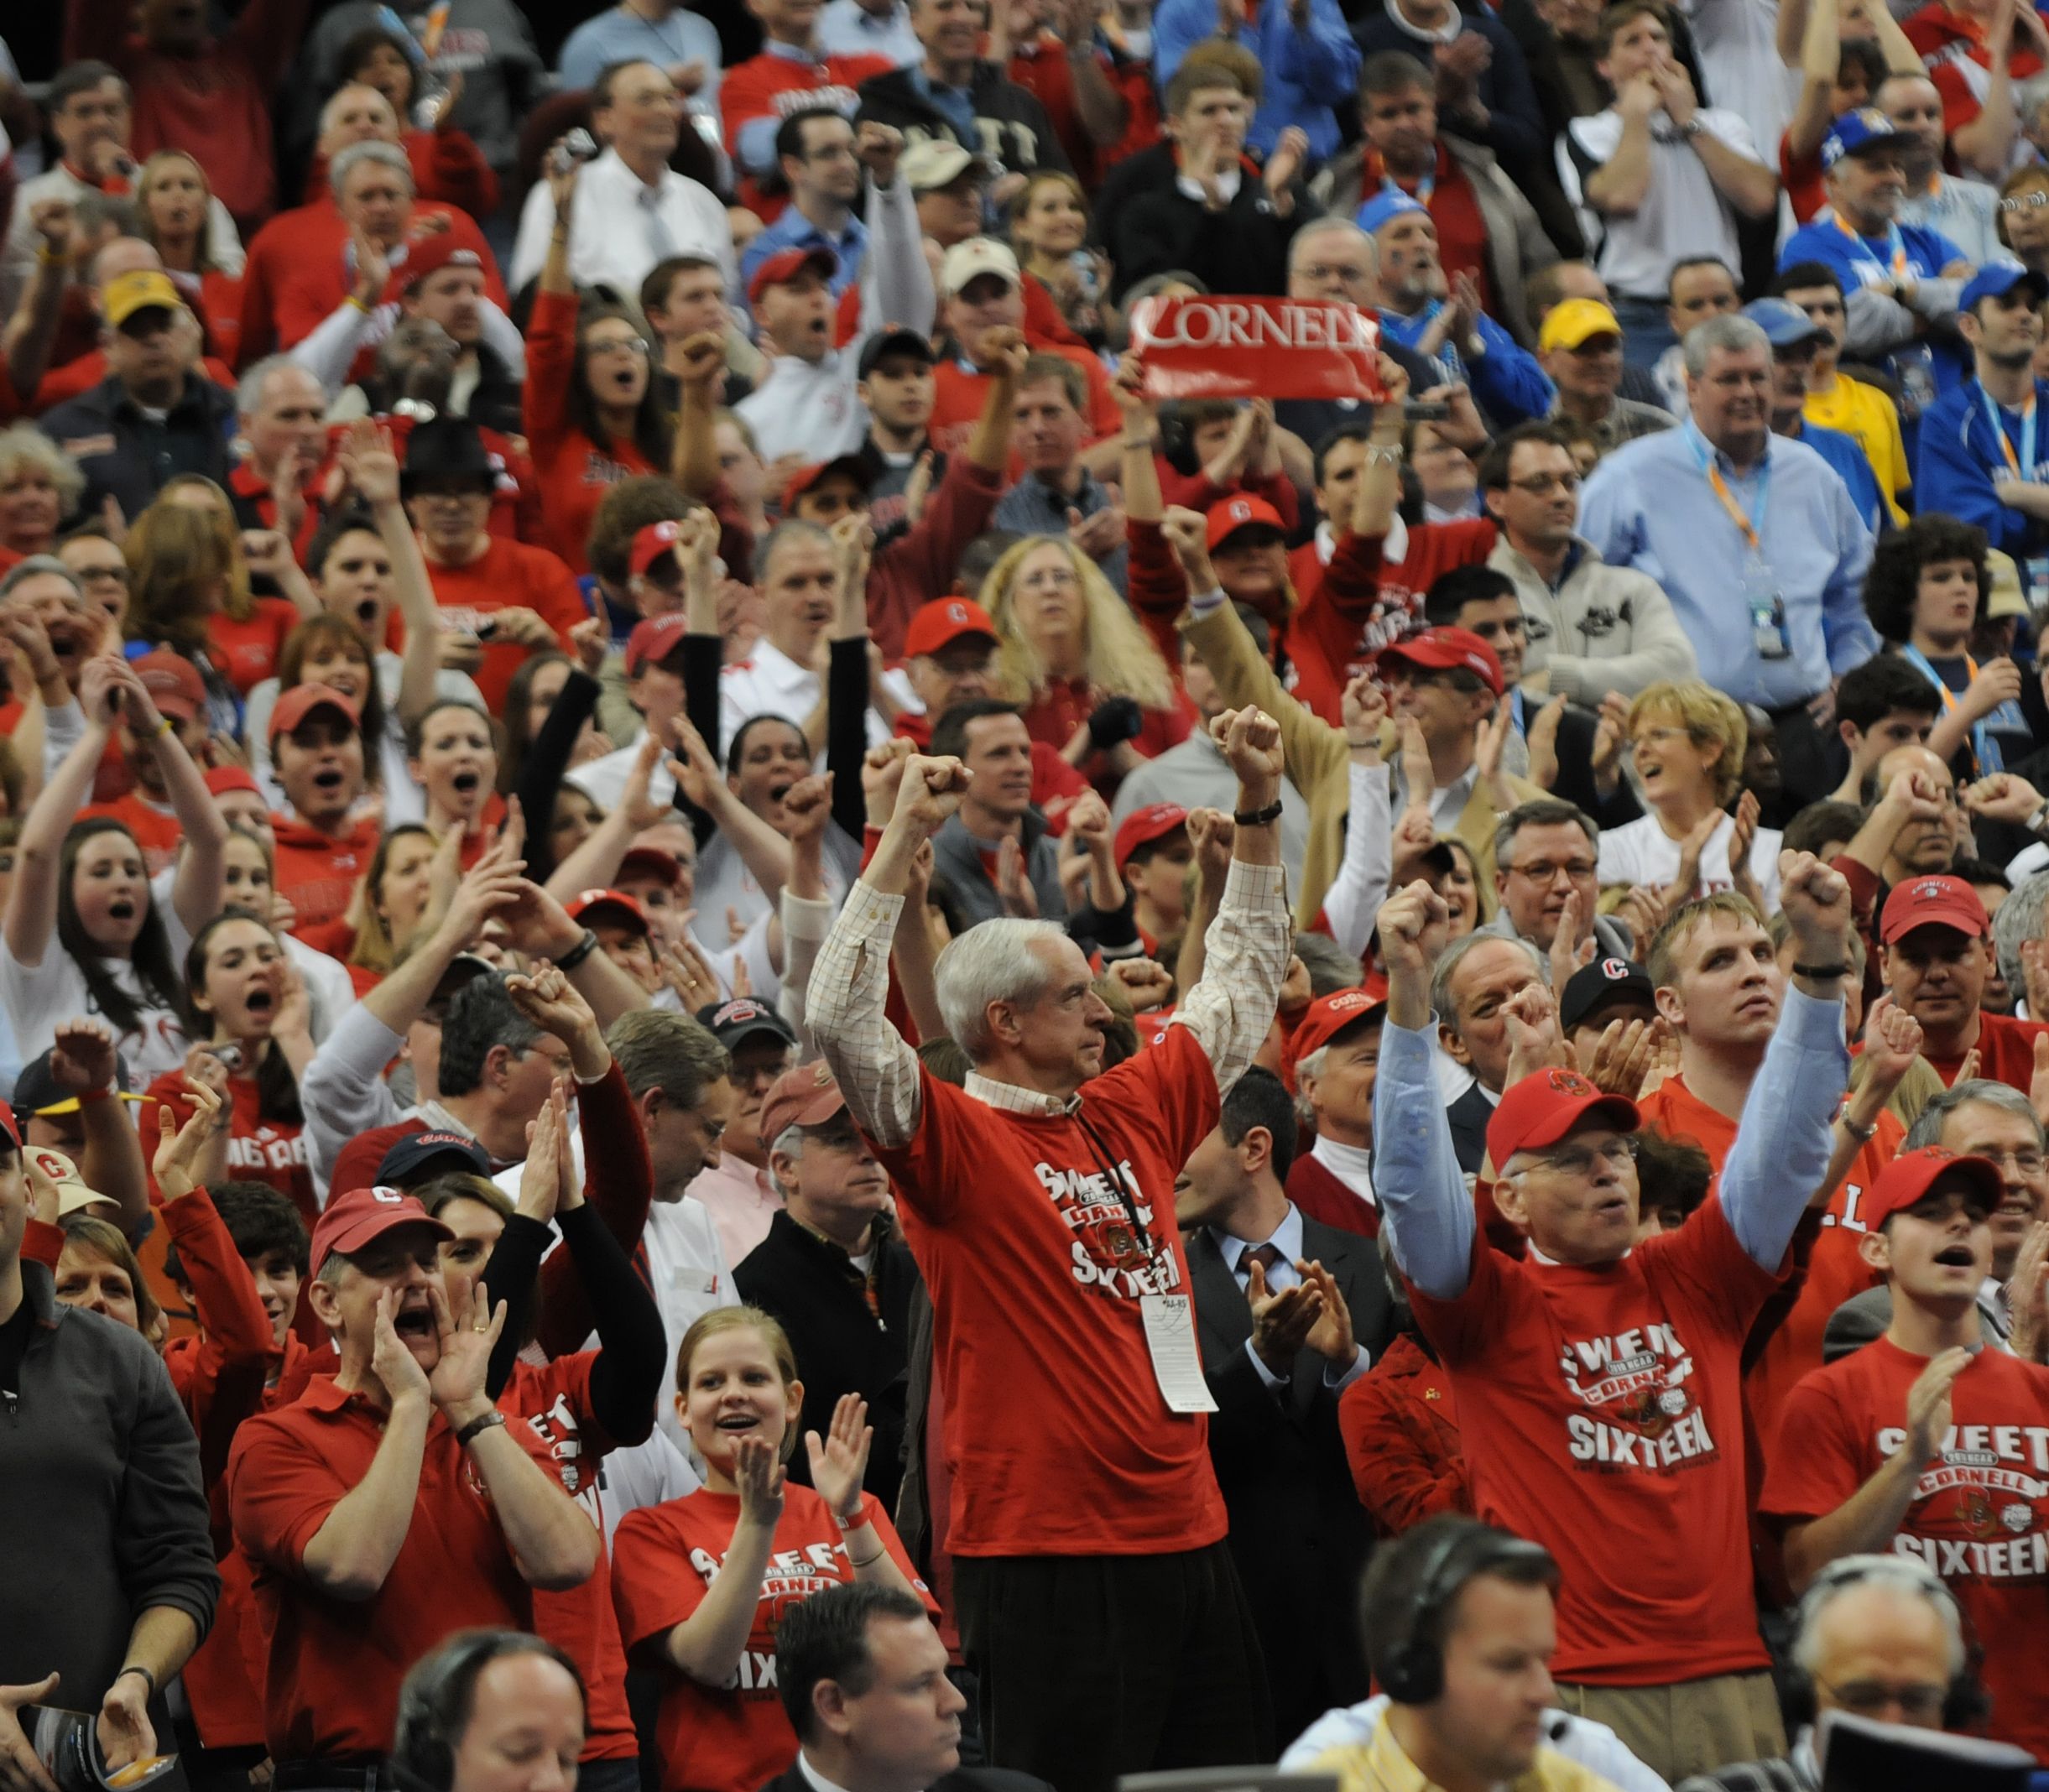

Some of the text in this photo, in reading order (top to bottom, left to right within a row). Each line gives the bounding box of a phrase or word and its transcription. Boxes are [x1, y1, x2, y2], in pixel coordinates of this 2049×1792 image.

[1602, 957, 1629, 980] C
[36, 1154, 67, 1179] C
[372, 1185, 402, 1203] C
[1567, 1406, 1715, 1469] SIXTEEN
[1876, 1425, 2049, 1474] SEET
[1918, 1466, 2027, 1493] CORNELL
[690, 1542, 850, 1590] SEE
